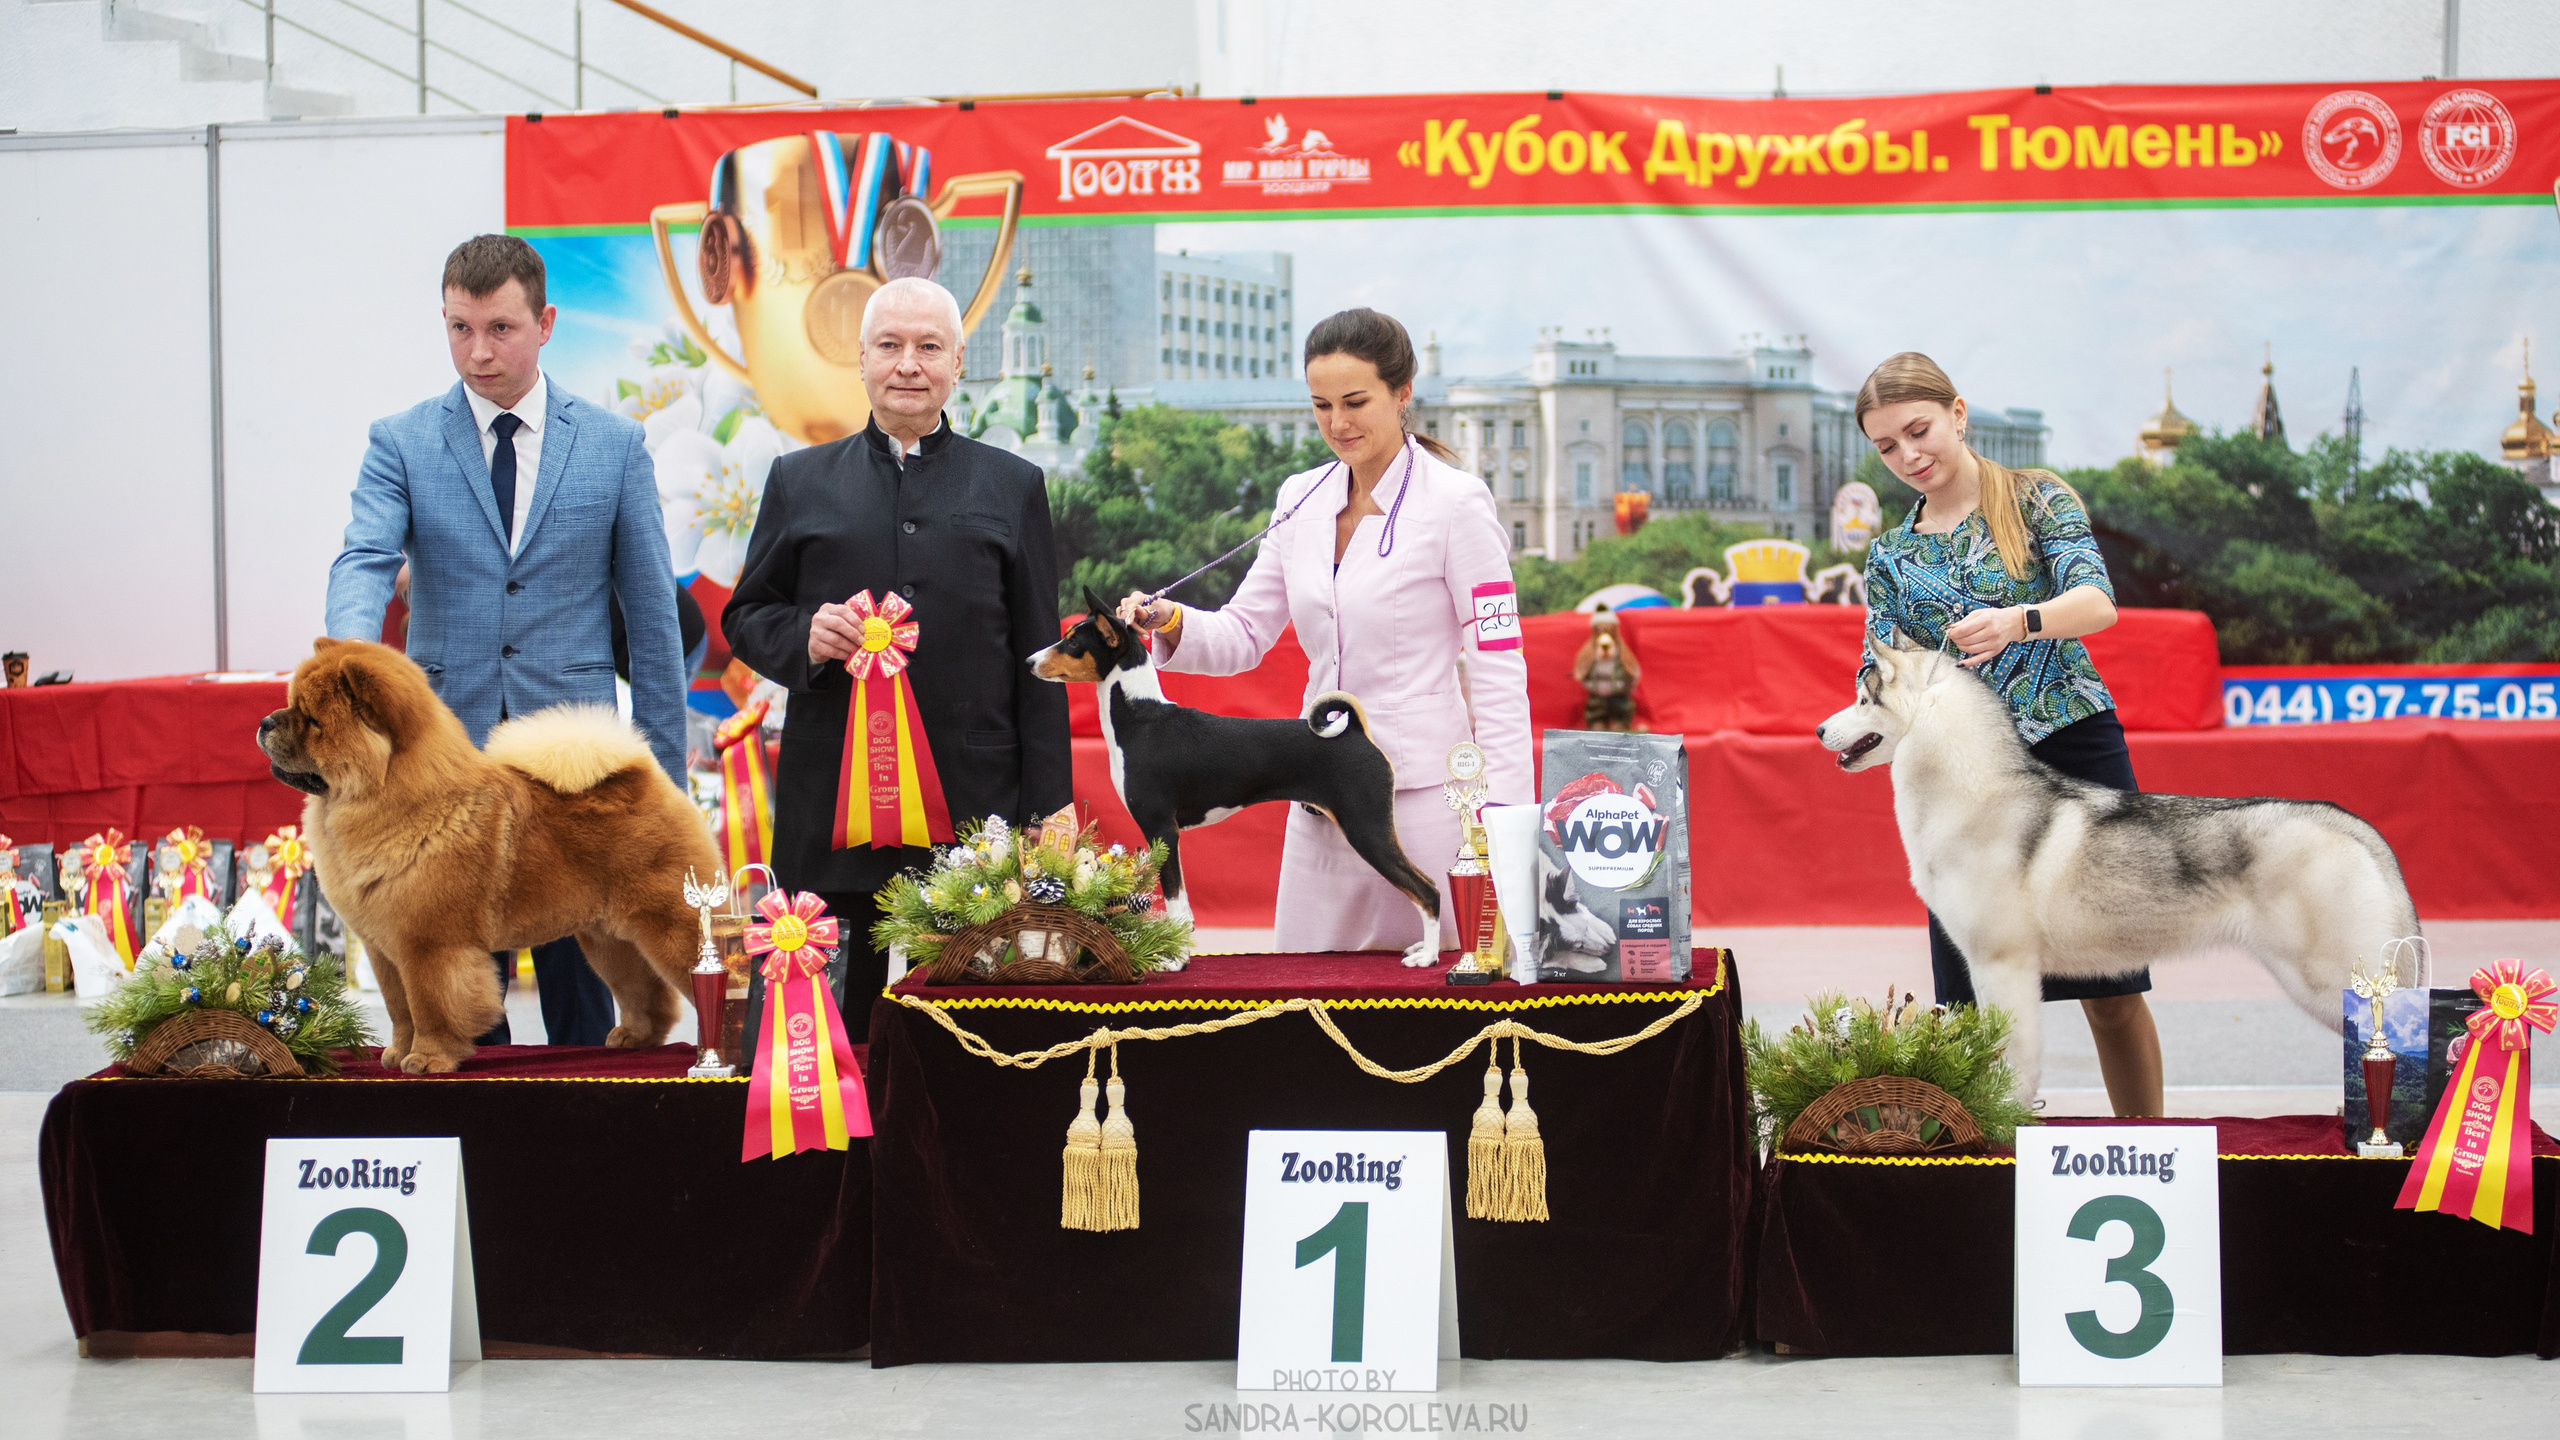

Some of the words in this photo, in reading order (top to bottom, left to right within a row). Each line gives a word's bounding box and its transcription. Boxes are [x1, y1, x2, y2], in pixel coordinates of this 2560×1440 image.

[2445, 125, 2490, 148] FCI
[1397, 114, 1632, 188] «Кубок
[1644, 117, 1950, 188] Дружбы.
[1967, 113, 2284, 172] Тюмень»
[1262, 182, 1331, 195] ЗООЦЕНТР
[2345, 684, 2558, 721] 97-75-05
[873, 736, 891, 744] DOG
[869, 746, 895, 754] SHOW
[873, 762, 893, 771] Best
[878, 773, 889, 782] In
[869, 784, 899, 795] Group
[1586, 808, 1639, 821] AlphaPet
[1554, 820, 1664, 860] WOW
[792, 1037, 811, 1048] DOG
[789, 1046, 815, 1056] SHOW
[793, 1063, 812, 1072] Best
[798, 1074, 809, 1083] In
[789, 1085, 820, 1095] Group
[2471, 1101, 2491, 1113] DOG
[2465, 1109, 2493, 1122] SHOW
[2464, 1126, 2485, 1139] Best
[2466, 1138, 2477, 1149] In
[2454, 1147, 2485, 1162] Group
[2051, 1145, 2176, 1184] ZooRing
[298, 1159, 418, 1196] ZooRing
[1281, 1152, 1403, 1191] ZooRing
[1295, 1201, 1369, 1363] 1
[2065, 1195, 2175, 1360] 3
[296, 1207, 409, 1365] 2
